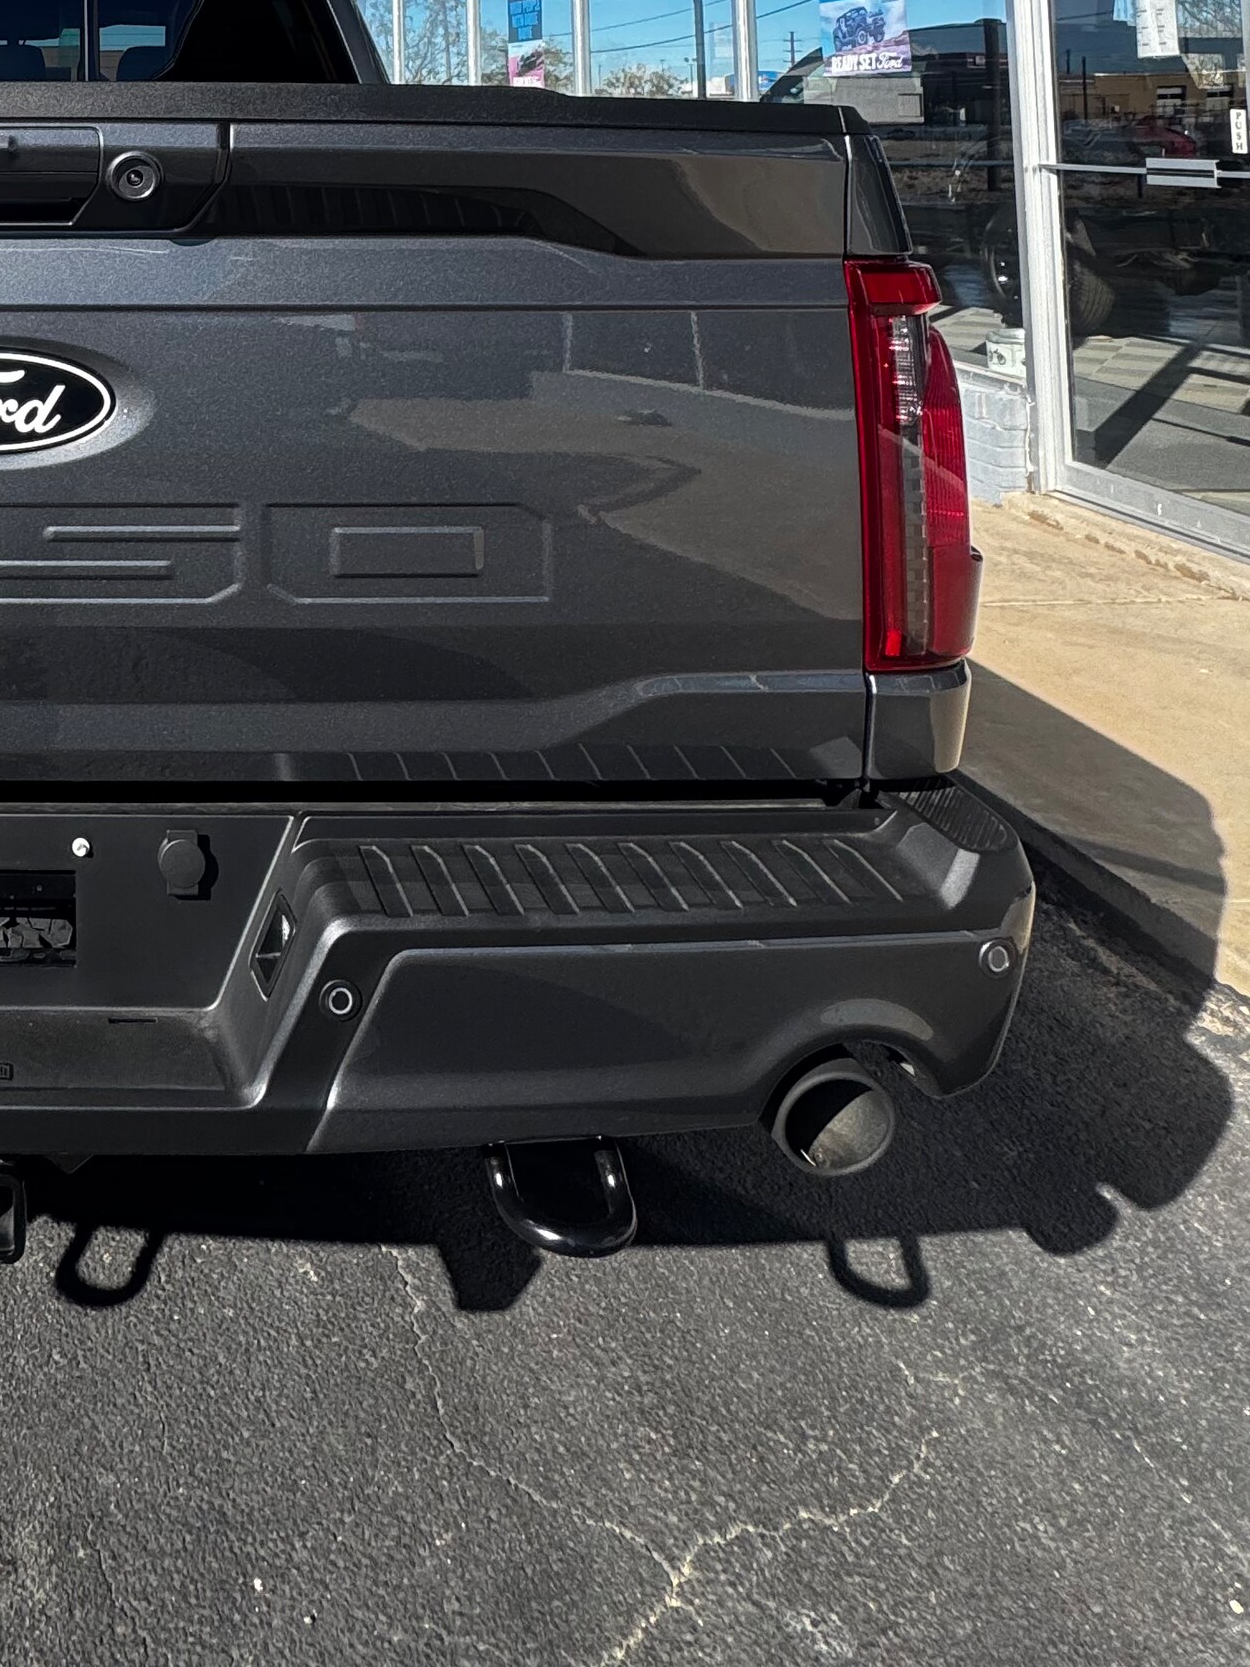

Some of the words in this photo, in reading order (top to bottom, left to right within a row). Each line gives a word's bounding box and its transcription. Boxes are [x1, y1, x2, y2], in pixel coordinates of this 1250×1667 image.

[859, 53, 877, 71] SET
[877, 52, 903, 70] Ford
[1235, 112, 1244, 151] PUSH
